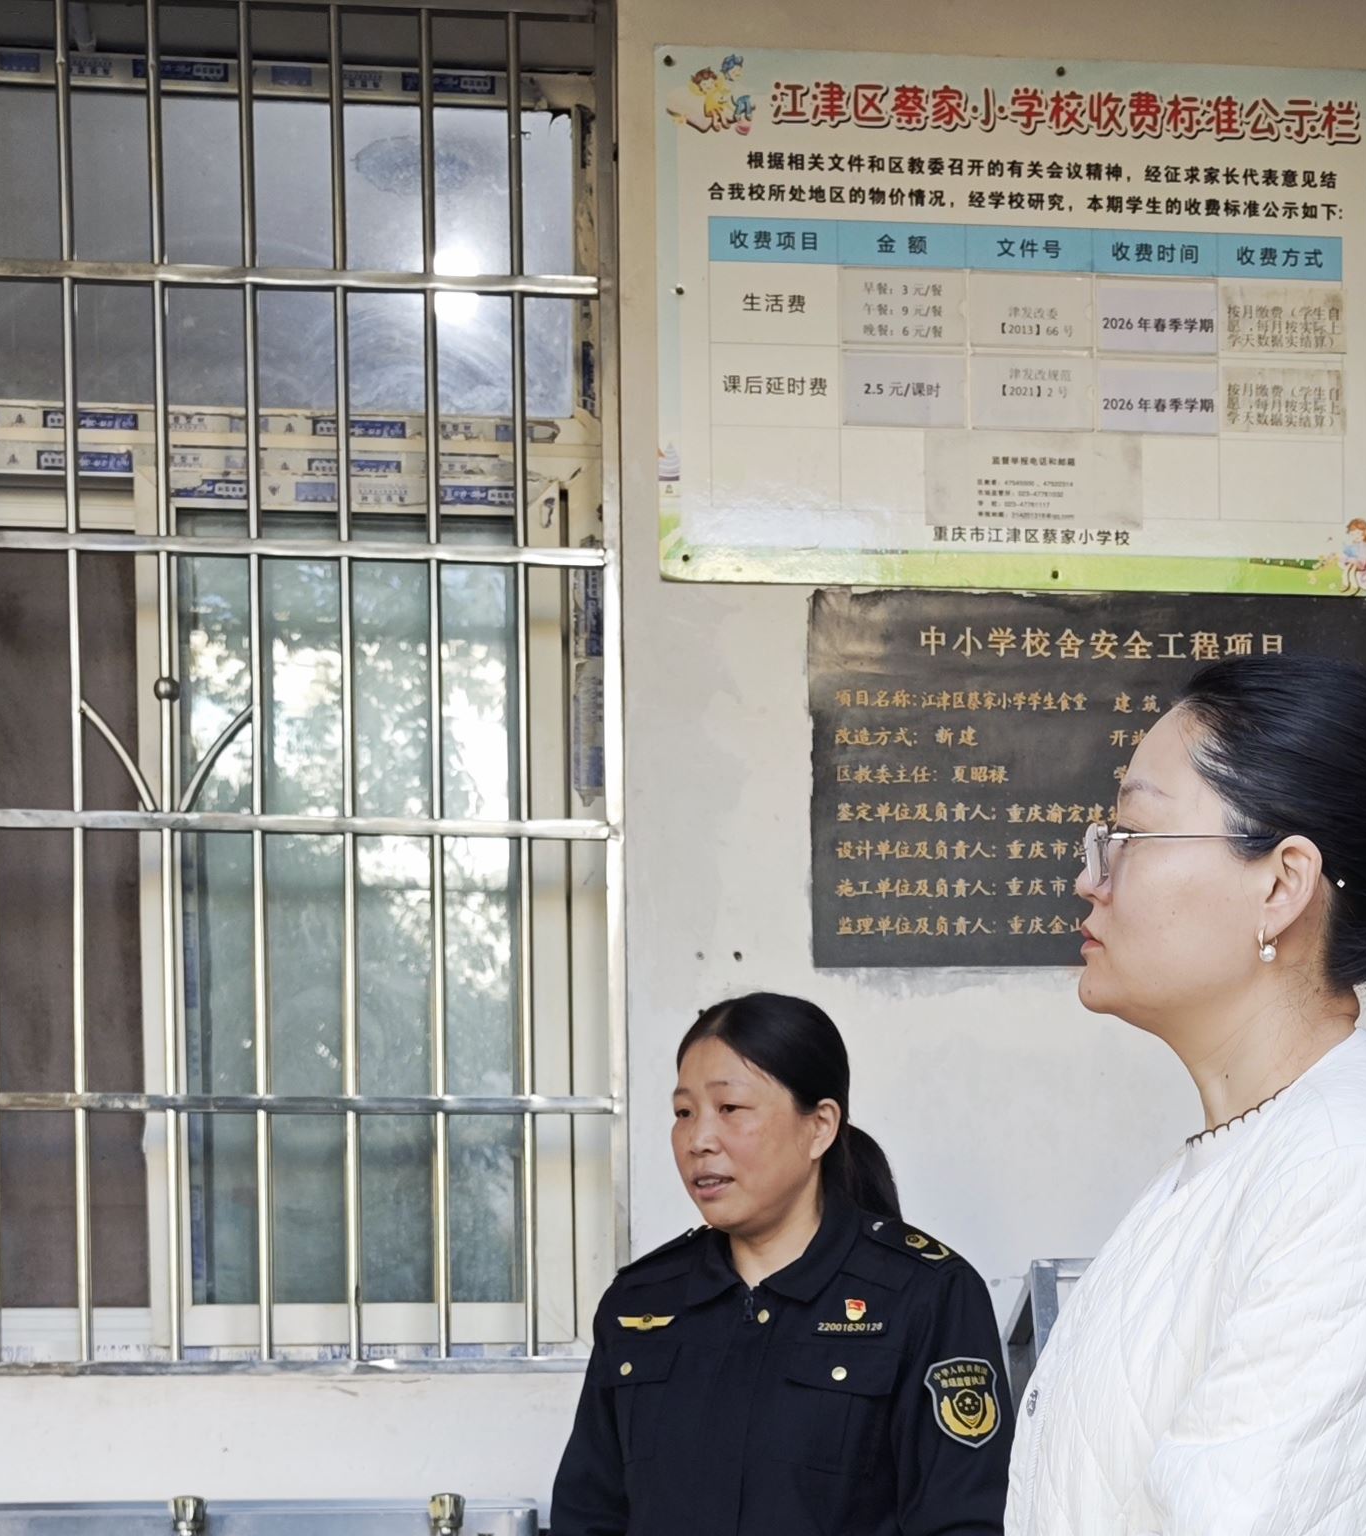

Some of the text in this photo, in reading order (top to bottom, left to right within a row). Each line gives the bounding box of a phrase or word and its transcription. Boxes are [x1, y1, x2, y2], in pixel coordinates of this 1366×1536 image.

[770, 80, 1359, 144] 江津区蔡家小学校收费标准公示栏
[746, 151, 1338, 190] 根据相关文件和区教委召开的有关会议精神，经征求家长代表意见结
[728, 230, 819, 251] 收费项目
[996, 238, 1062, 259] 文件号
[1111, 242, 1200, 265] 收费时间
[1236, 246, 1324, 269] 收费方式
[741, 293, 807, 314] 生活费
[721, 374, 828, 397] 课后延时费
[933, 526, 1131, 546] 重庆市江津区蔡家小学校
[919, 625, 1284, 661] 中小学校舍安全工程项目
[934, 725, 979, 747] 新建
[1004, 876, 1078, 899] 重庆市
